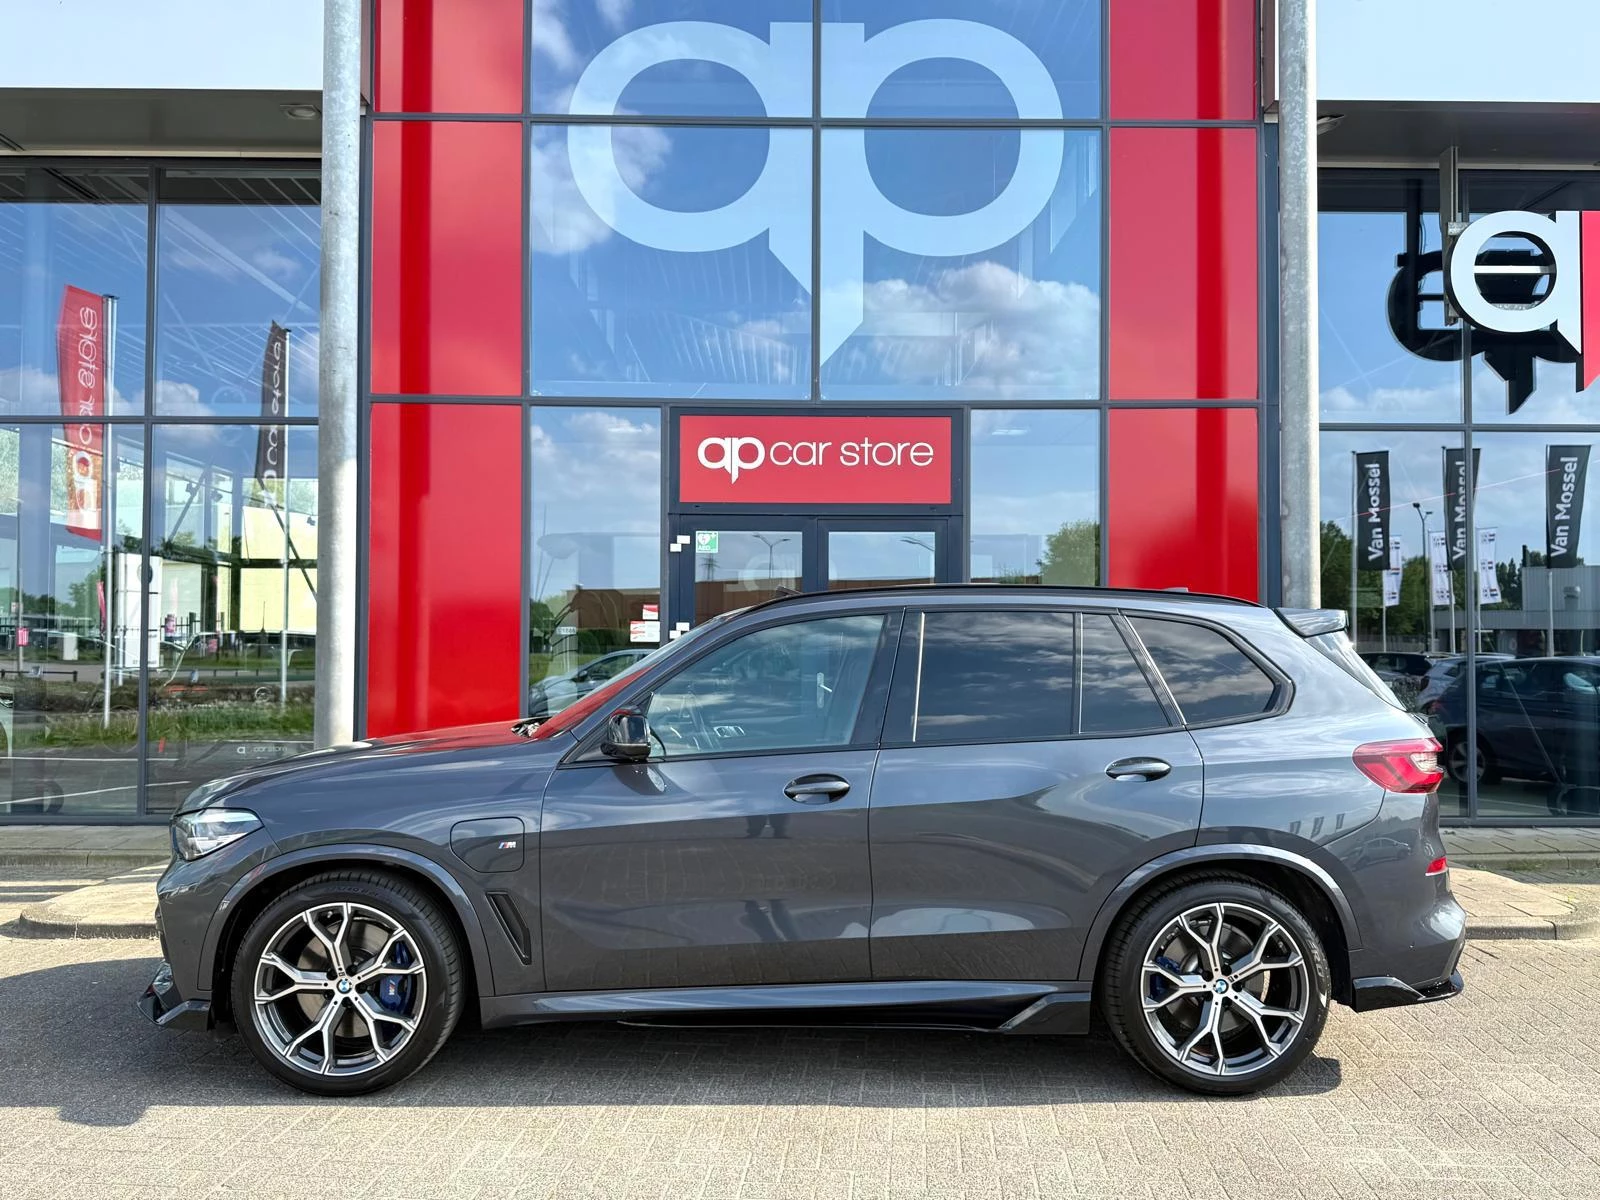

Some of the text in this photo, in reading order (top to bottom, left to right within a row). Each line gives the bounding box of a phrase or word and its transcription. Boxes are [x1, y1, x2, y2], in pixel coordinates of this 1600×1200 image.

[568, 18, 1064, 368] ap
[697, 437, 935, 485] ap car store
[1550, 456, 1579, 558] Van Mossel
[1364, 462, 1384, 561] Van Mossel
[1452, 526, 1467, 560] Van
